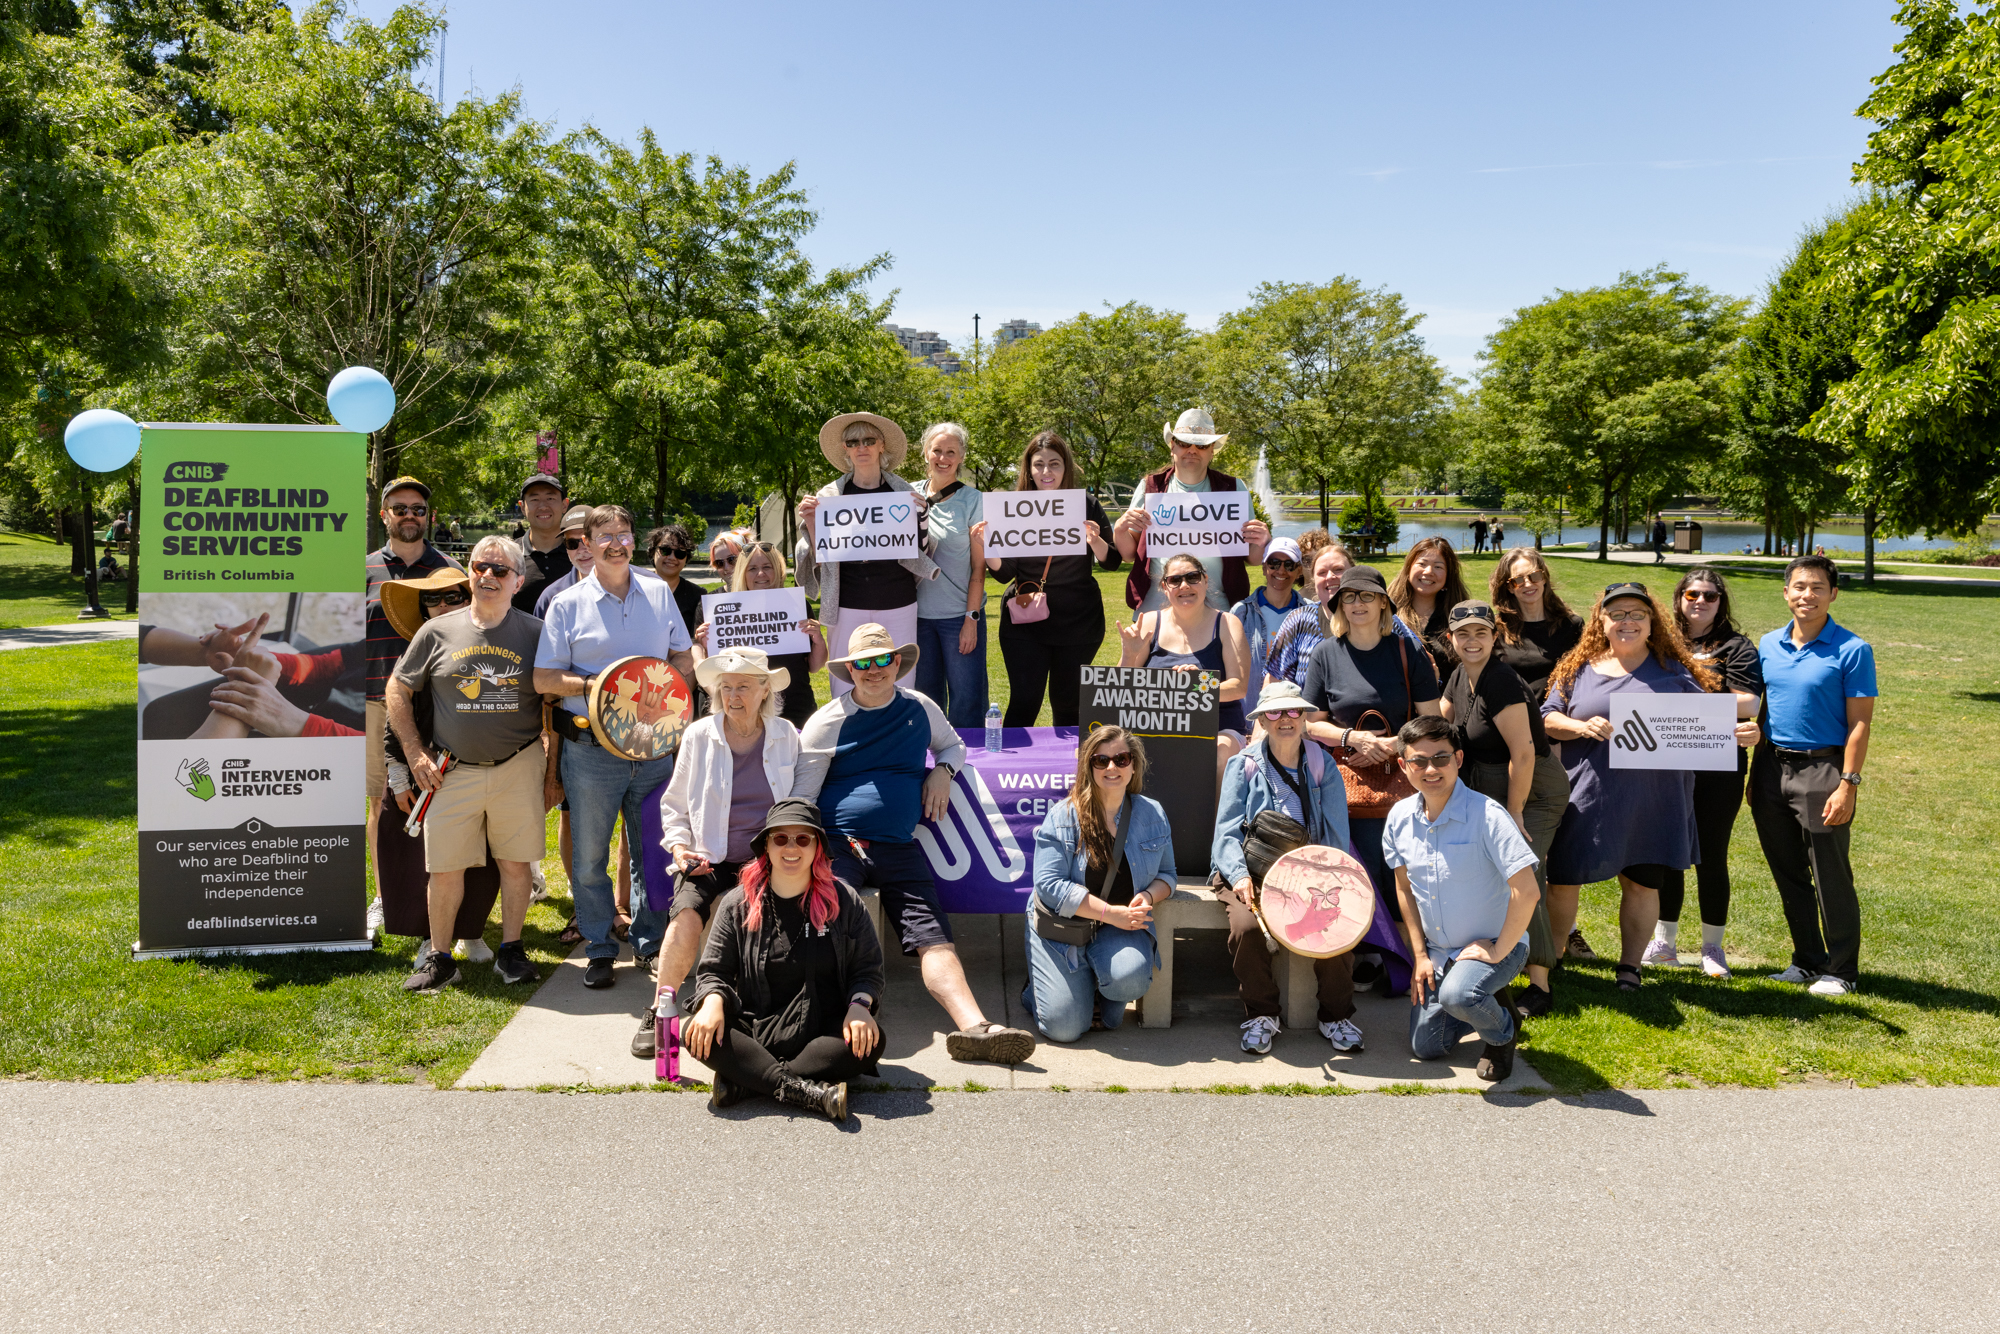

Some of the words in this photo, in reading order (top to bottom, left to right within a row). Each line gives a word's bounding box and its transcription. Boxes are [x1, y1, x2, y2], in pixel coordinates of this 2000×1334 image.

[172, 465, 215, 479] CNIB
[164, 487, 329, 508] DEAFBLIND
[823, 506, 884, 527] LOVE
[1004, 499, 1065, 518] LOVE
[1179, 503, 1240, 522] LOVE
[163, 511, 349, 532] COMMUNITY
[162, 535, 303, 556] SERVICES
[817, 533, 916, 551] AUTONOMY
[988, 527, 1081, 548] ACCESS
[1147, 531, 1246, 546] INCLUSION
[164, 569, 216, 581] British
[221, 569, 295, 581] Columbia
[717, 604, 737, 612] CNIB
[715, 611, 788, 626] DEAFBLIND
[716, 621, 798, 638] COMMUNITY
[717, 635, 780, 649] SERVICES
[1080, 666, 1191, 690] DEAFBLIND
[1092, 688, 1215, 712] AWARENESS
[1119, 710, 1191, 732] MONTH
[1660, 733, 1732, 741] COMMUNICATION
[225, 760, 245, 768] CNIB
[222, 768, 332, 783] INTERVENOR
[997, 773, 1078, 790] WAVEF
[221, 783, 303, 797] SERVICES
[156, 840, 183, 852] Our
[188, 839, 247, 851] services
[251, 836, 299, 849] enable
[303, 835, 350, 850] people
[178, 855, 209, 868] who
[213, 856, 237, 867] are
[242, 852, 309, 866] Deafblind
[314, 853, 328, 864] to
[201, 870, 270, 883] maximize
[274, 868, 308, 881] their
[204, 885, 304, 901] independence
[187, 914, 318, 930] deafblindservices.ca
